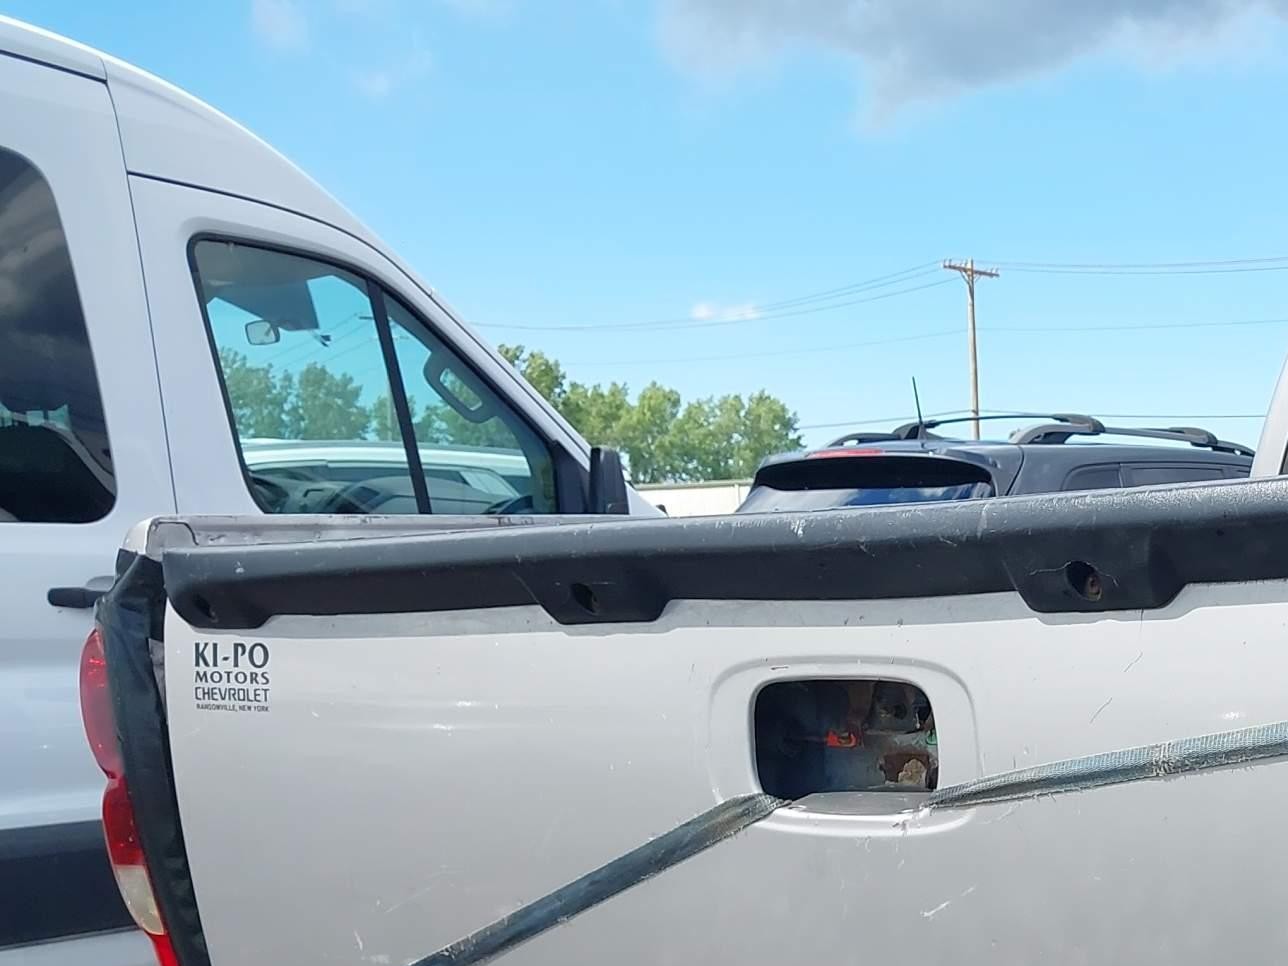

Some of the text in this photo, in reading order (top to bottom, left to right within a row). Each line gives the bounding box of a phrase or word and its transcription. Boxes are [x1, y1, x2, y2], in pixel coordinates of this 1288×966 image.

[194, 642, 270, 668] KI-PO
[194, 670, 270, 685] MOTORS
[194, 686, 270, 702] CHEVROLET
